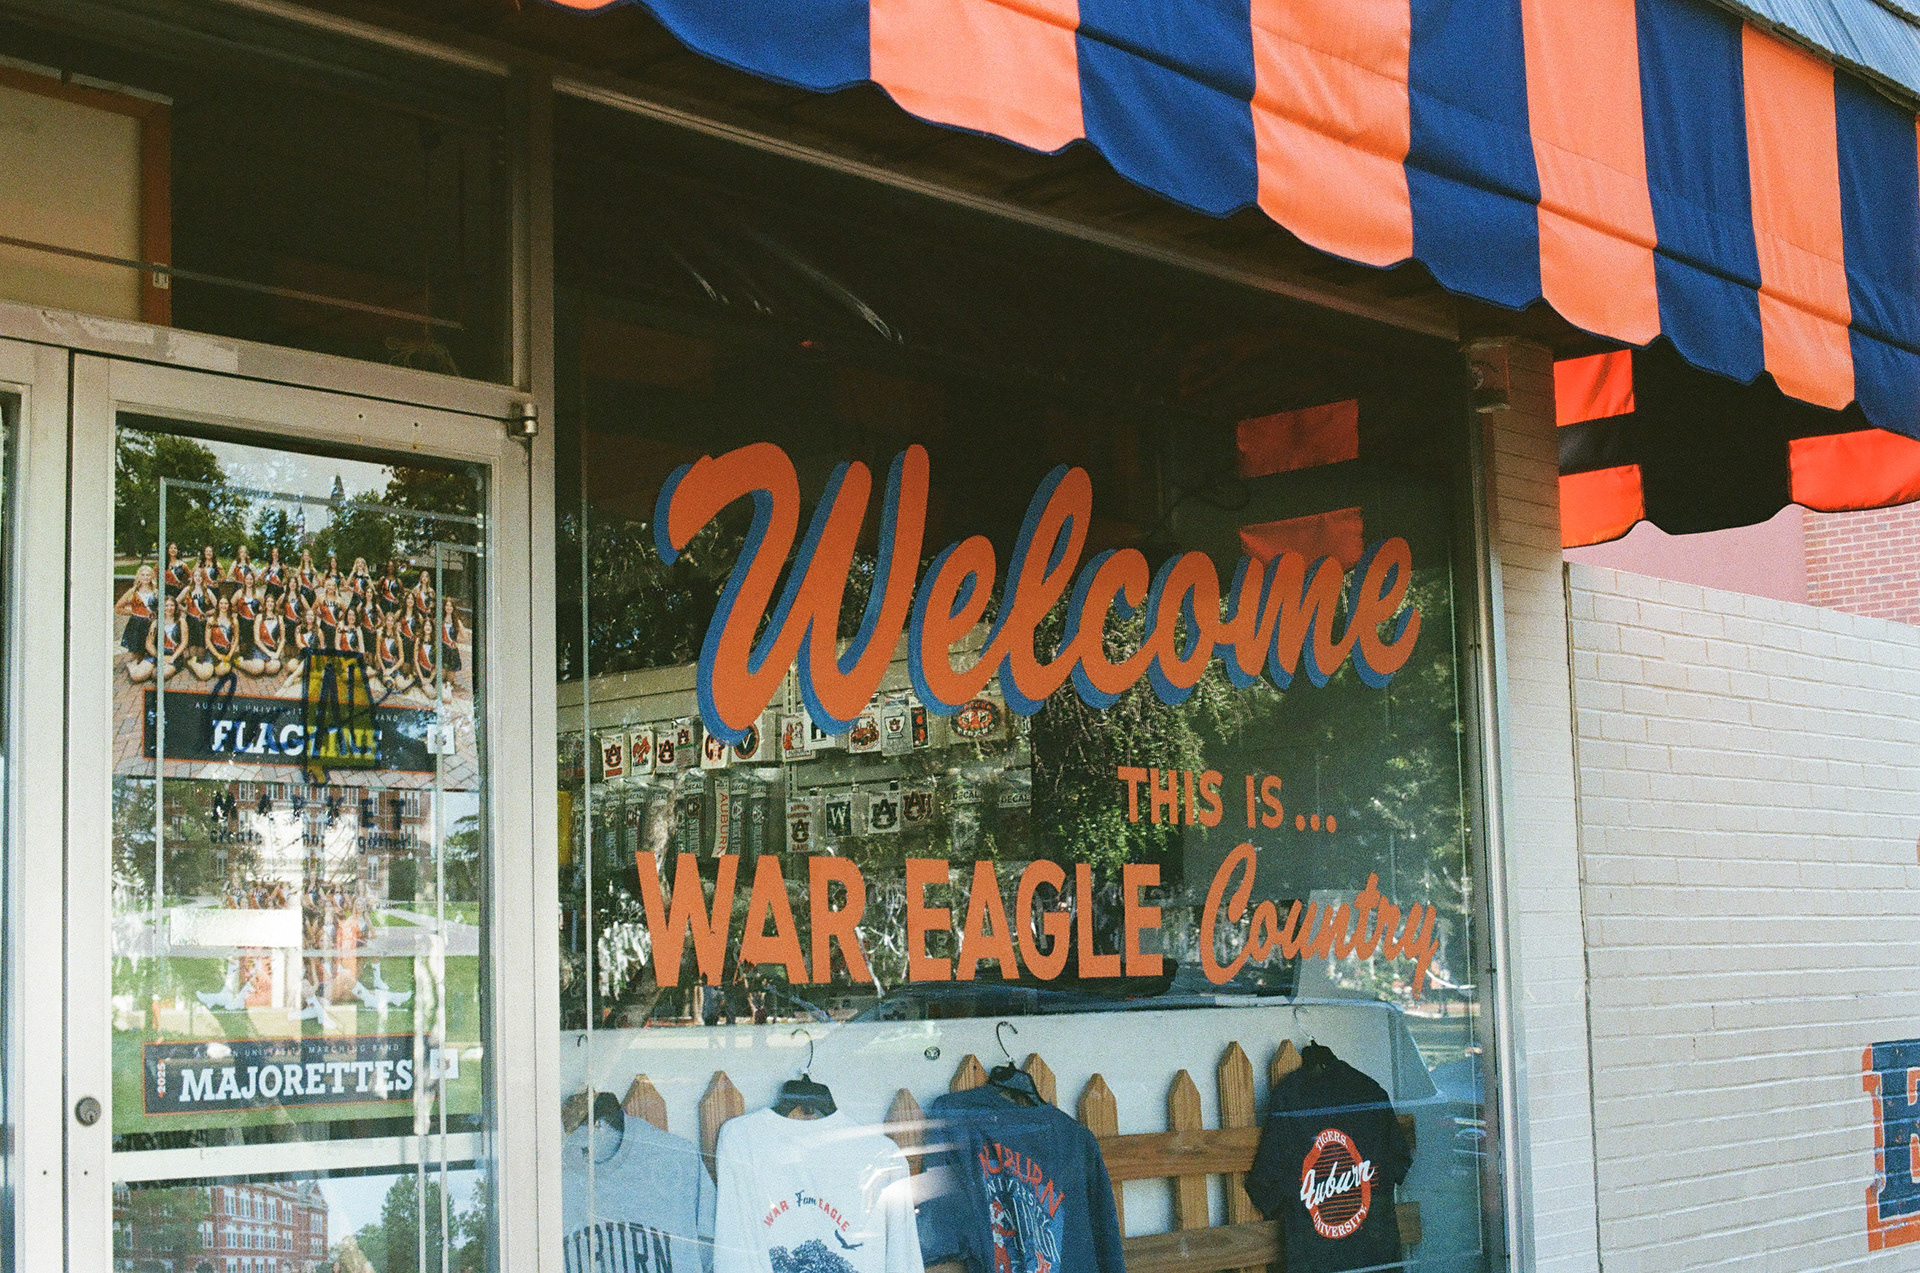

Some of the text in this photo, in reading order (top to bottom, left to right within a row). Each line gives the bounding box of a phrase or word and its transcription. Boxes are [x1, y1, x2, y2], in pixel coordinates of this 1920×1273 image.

[654, 441, 1421, 746] Welcome
[1117, 766, 1223, 827] THIS
[717, 792, 729, 856] AUBURN
[636, 843, 1439, 999] WAR EAGLE Country
[179, 1059, 414, 1102] MAJORETTES
[1315, 1130, 1347, 1151] TIGERS
[1300, 1160, 1375, 1210] Auburn
[763, 1200, 790, 1227] WAR
[818, 1197, 851, 1233] EAGLE
[1313, 1205, 1367, 1238] UNIVERSITY
